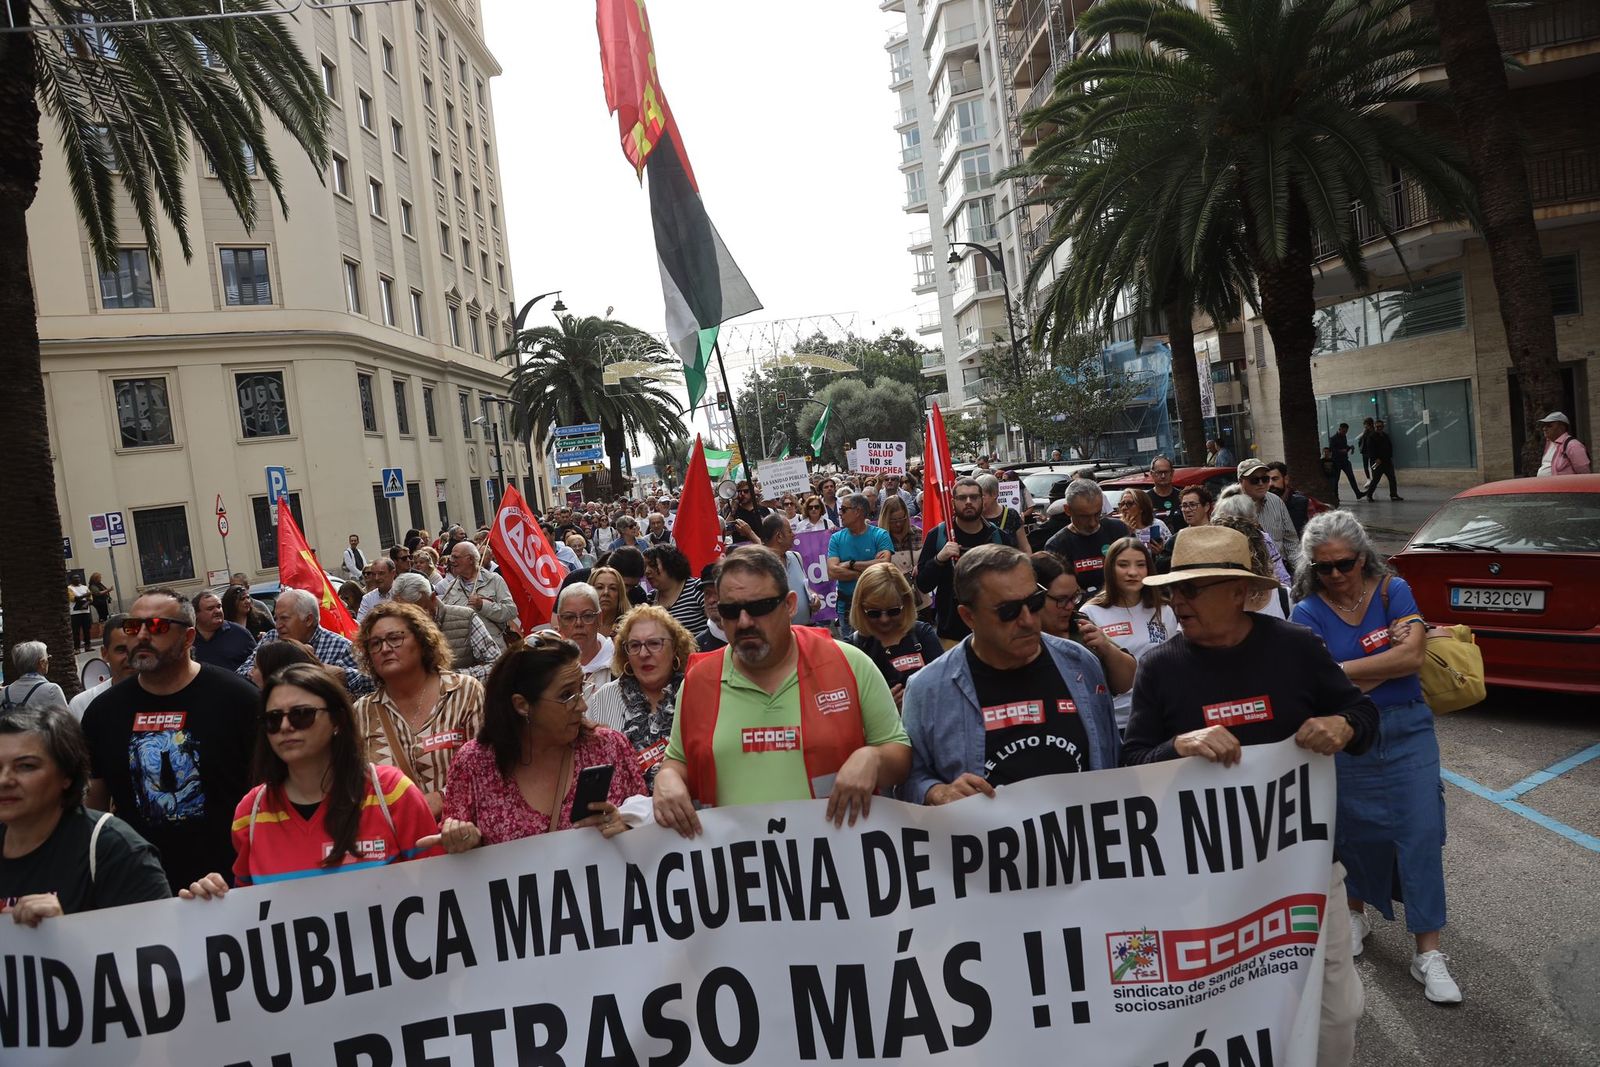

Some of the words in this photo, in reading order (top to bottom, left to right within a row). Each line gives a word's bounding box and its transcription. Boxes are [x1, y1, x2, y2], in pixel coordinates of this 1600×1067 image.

[868, 450, 894, 458] SALUD
[860, 465, 902, 474] TRAPICHEA
[270, 470, 284, 501] P
[769, 478, 788, 486] SANIDAD
[108, 514, 122, 530] P
[508, 520, 558, 586] ASC
[1464, 590, 1532, 606] 2132CCV
[818, 690, 846, 704] CCOO
[984, 705, 1028, 722] CCOO
[1058, 702, 1076, 710] CC
[1208, 702, 1254, 720] CCOO
[138, 714, 174, 724] CCOO
[743, 730, 785, 743] CCOO
[996, 736, 1040, 760] LUTO
[1046, 734, 1077, 755] POR
[206, 889, 477, 1022] PÚBLICA
[489, 818, 850, 962] MALAGUEÑA
[861, 827, 936, 918] DE
[951, 796, 1166, 899] PRIMER
[1179, 763, 1328, 874] NIVEL
[1176, 908, 1287, 970] CCOO
[1113, 984, 1184, 998] sindicato
[1188, 980, 1206, 994] de
[1208, 957, 1256, 986] sanidad
[1258, 954, 1266, 968] y
[789, 928, 992, 1060] MÁS
[1115, 984, 1226, 1013] sociosanitarios
[1230, 976, 1245, 989] de
[1248, 958, 1299, 982] Málaga
